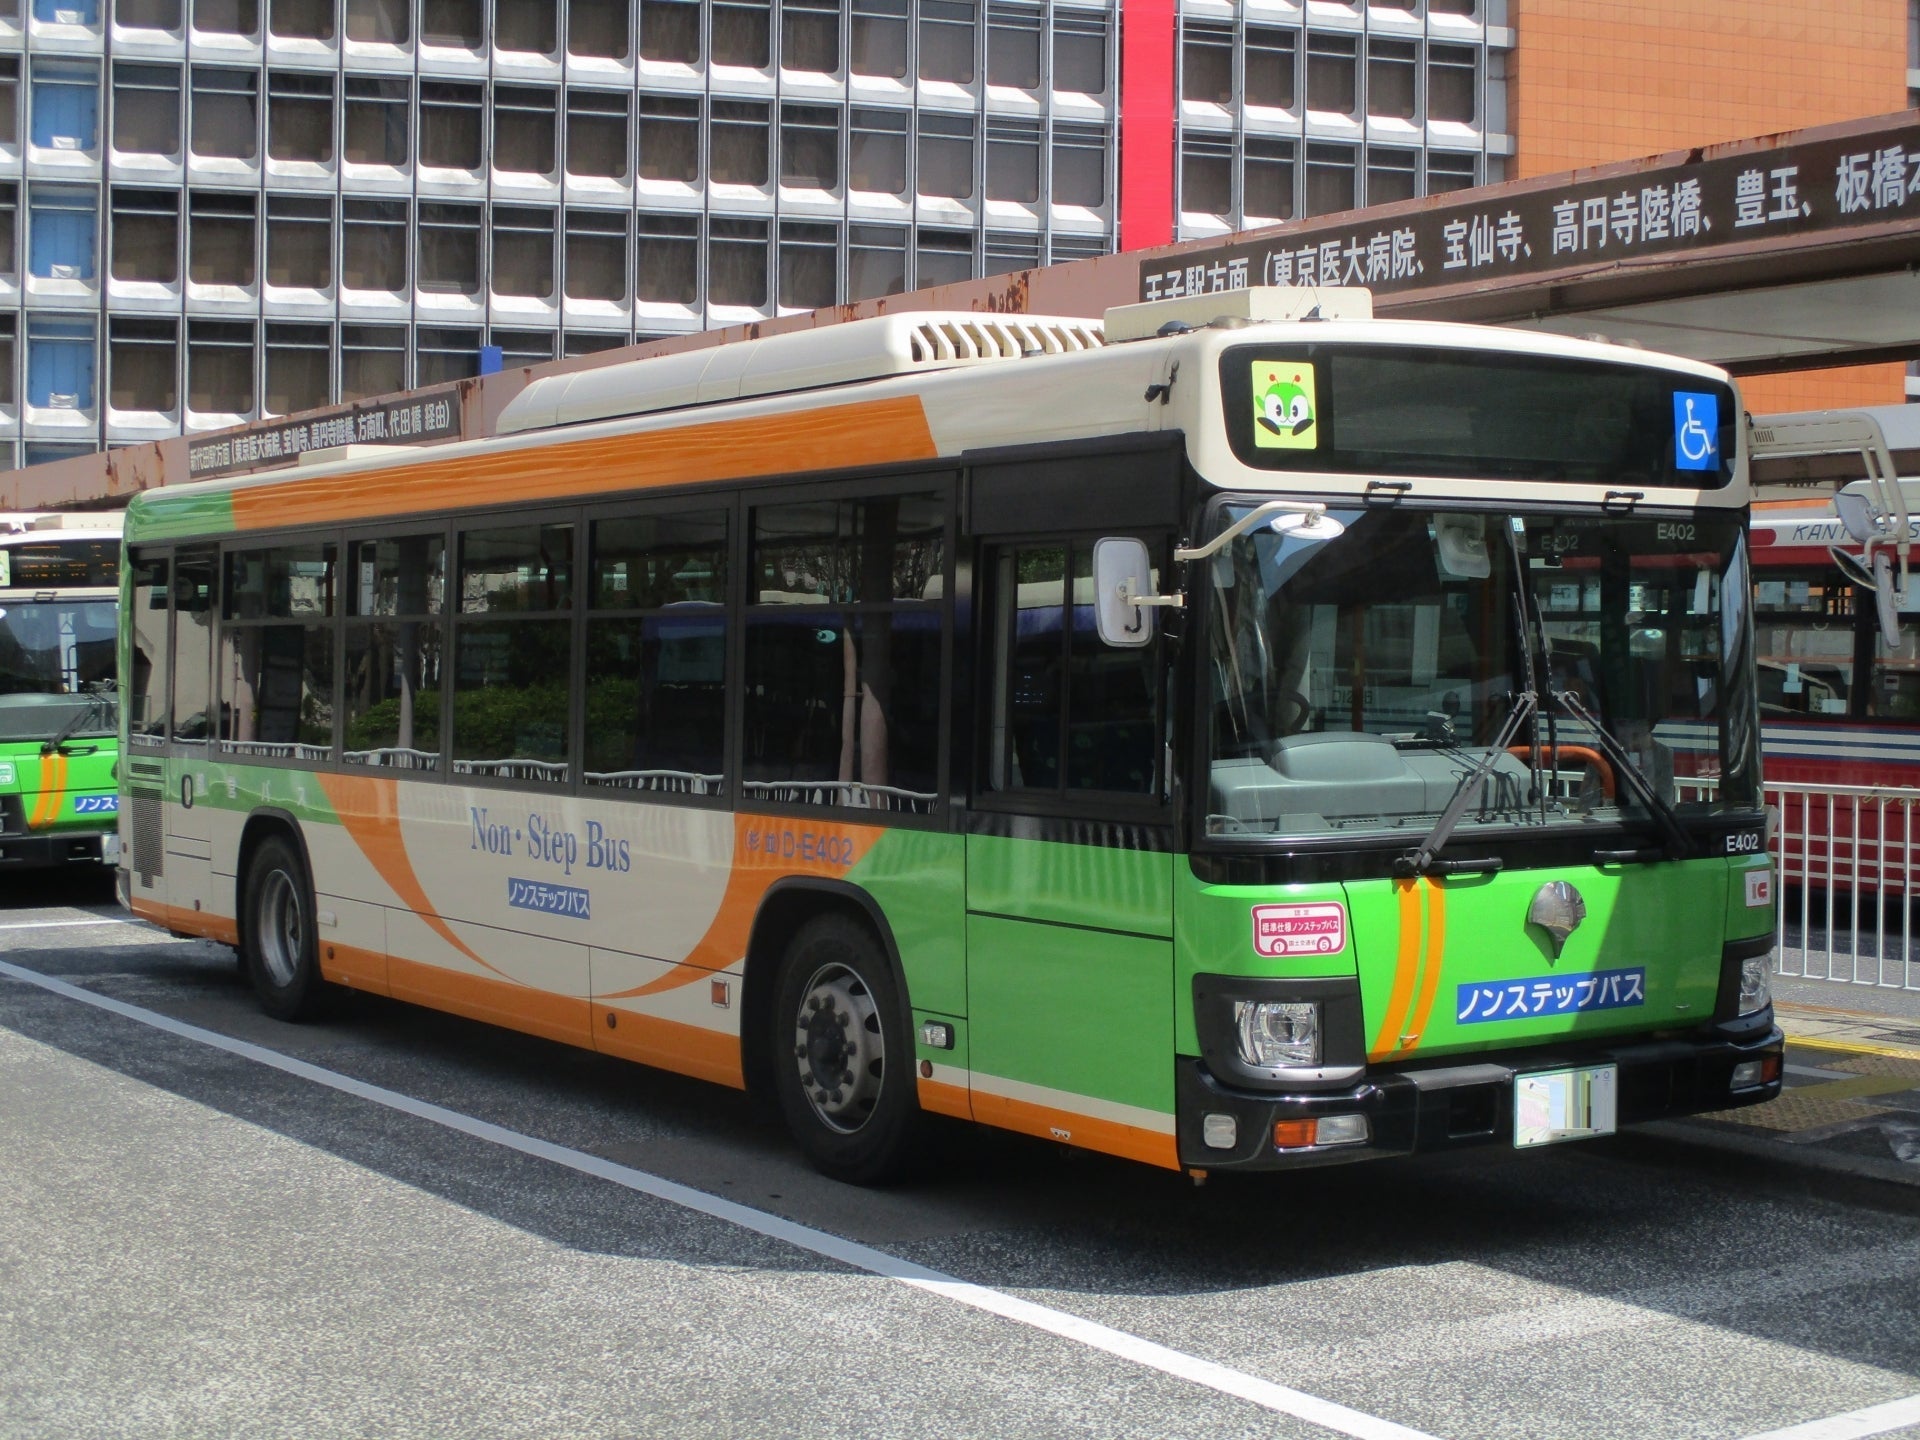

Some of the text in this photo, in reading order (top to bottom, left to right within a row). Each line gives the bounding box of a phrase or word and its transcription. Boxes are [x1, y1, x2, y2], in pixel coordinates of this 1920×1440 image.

[1657, 523, 1695, 540] E402
[76, 797, 119, 812] ノンス
[586, 820, 631, 872] Bus
[1726, 834, 1759, 852] E402
[510, 882, 590, 916] ノンステップバス
[1458, 974, 1643, 1020] ノンステップバス
